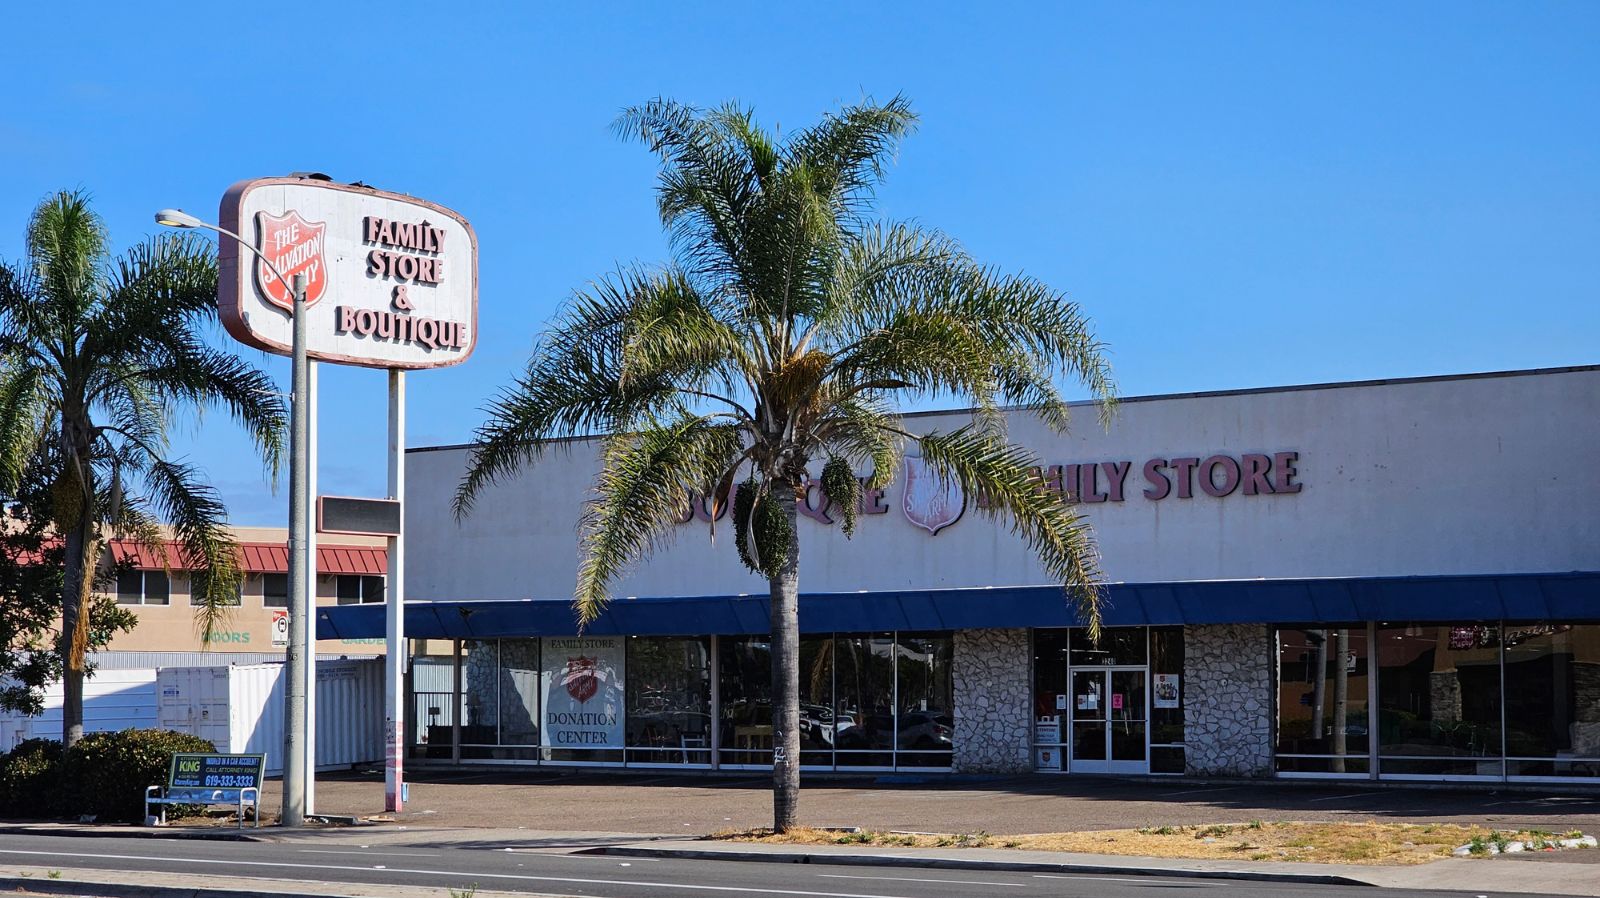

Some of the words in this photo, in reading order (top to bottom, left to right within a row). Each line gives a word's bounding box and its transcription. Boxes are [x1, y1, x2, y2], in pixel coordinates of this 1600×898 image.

[274, 223, 300, 252] THE
[363, 216, 447, 253] FAMILY
[264, 231, 321, 284] SALVATION
[366, 249, 444, 284] STORE
[391, 285, 416, 312] &
[336, 305, 467, 350] BOUTIQUE
[1143, 452, 1303, 500] STORE
[551, 639, 582, 649] FAMILY
[585, 639, 615, 649] STORE
[548, 712, 617, 726] DONATION
[557, 730, 608, 744] CENTER
[179, 761, 201, 772] KING
[205, 775, 254, 786] 619-333-3333
